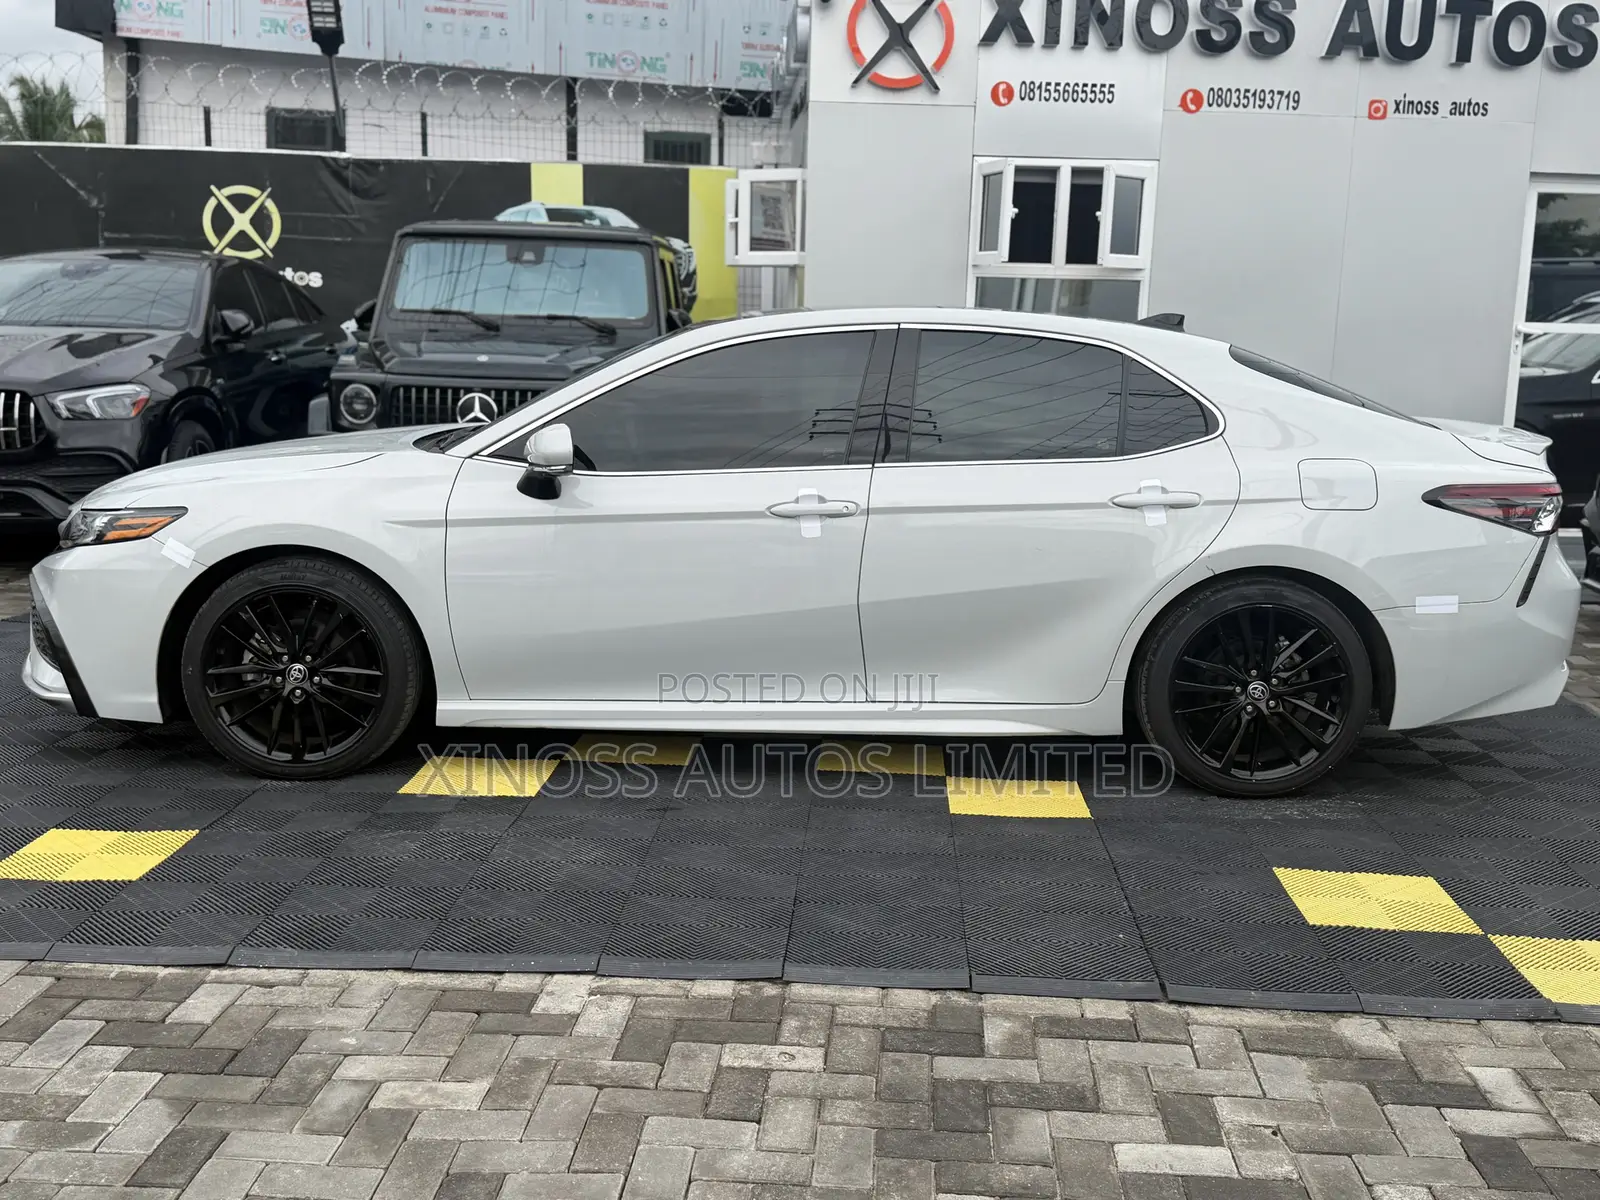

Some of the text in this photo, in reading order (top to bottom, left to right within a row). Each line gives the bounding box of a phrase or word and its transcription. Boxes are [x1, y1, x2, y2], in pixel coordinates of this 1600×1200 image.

[978, 0, 1600, 70] XINOSS AUTOS
[1018, 80, 1116, 104] 08155665555
[1207, 87, 1301, 111] 08035193719
[278, 266, 323, 288] tos
